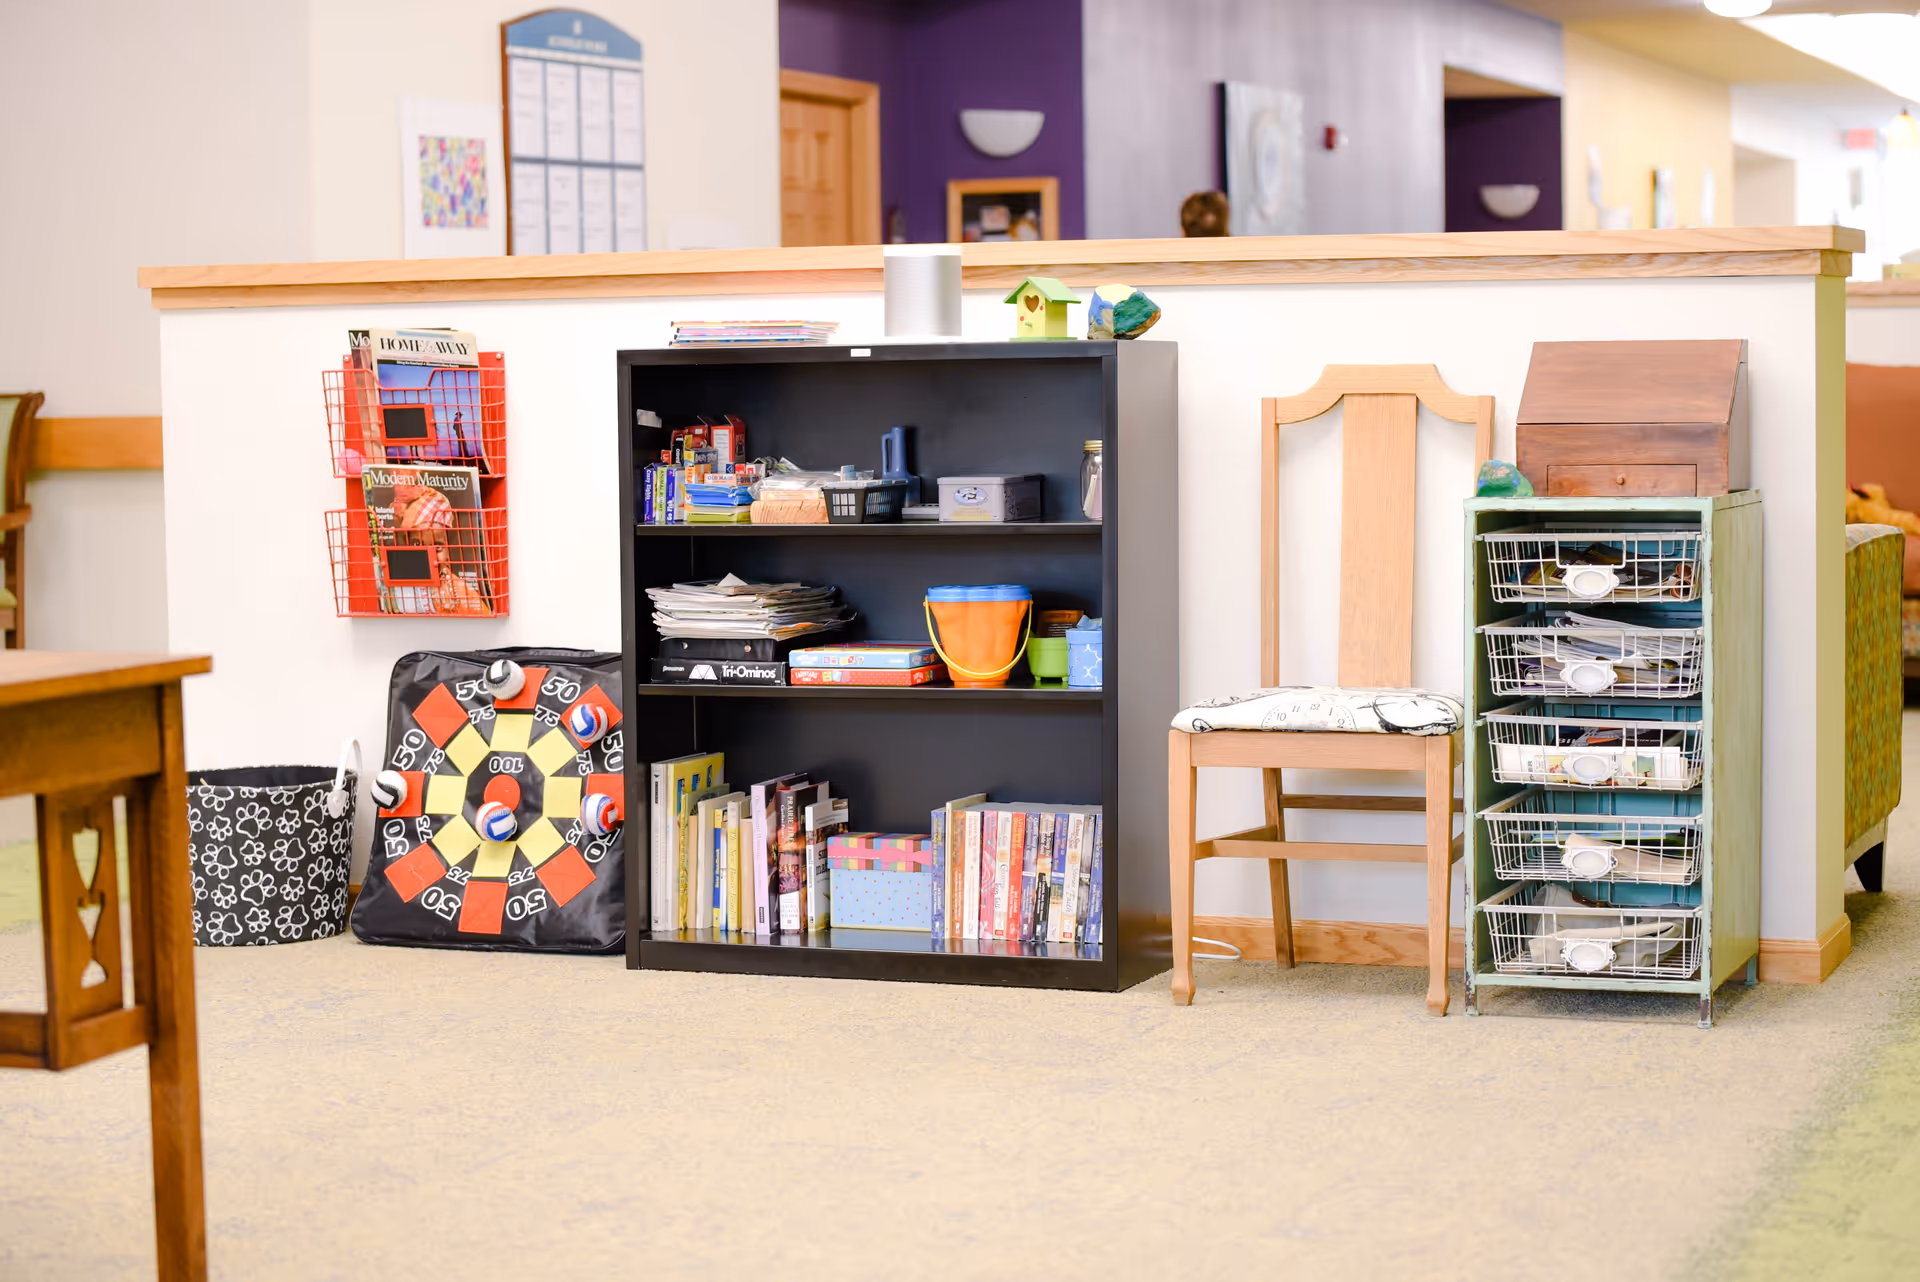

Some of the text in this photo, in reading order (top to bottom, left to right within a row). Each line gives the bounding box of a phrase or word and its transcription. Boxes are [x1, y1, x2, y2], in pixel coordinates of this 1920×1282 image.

[370, 470, 415, 485] Modern
[418, 471, 469, 490] Maturity
[542, 677, 581, 703] 50
[468, 705, 496, 725] 75
[534, 705, 561, 726] 75
[392, 728, 427, 771] 50
[423, 747, 446, 775] 75
[576, 750, 594, 775] 75
[383, 818, 409, 858] 50
[415, 814, 433, 842] 75
[446, 866, 472, 886] 75
[508, 866, 535, 886] 75
[421, 887, 463, 921] 50
[505, 888, 548, 920] 50
